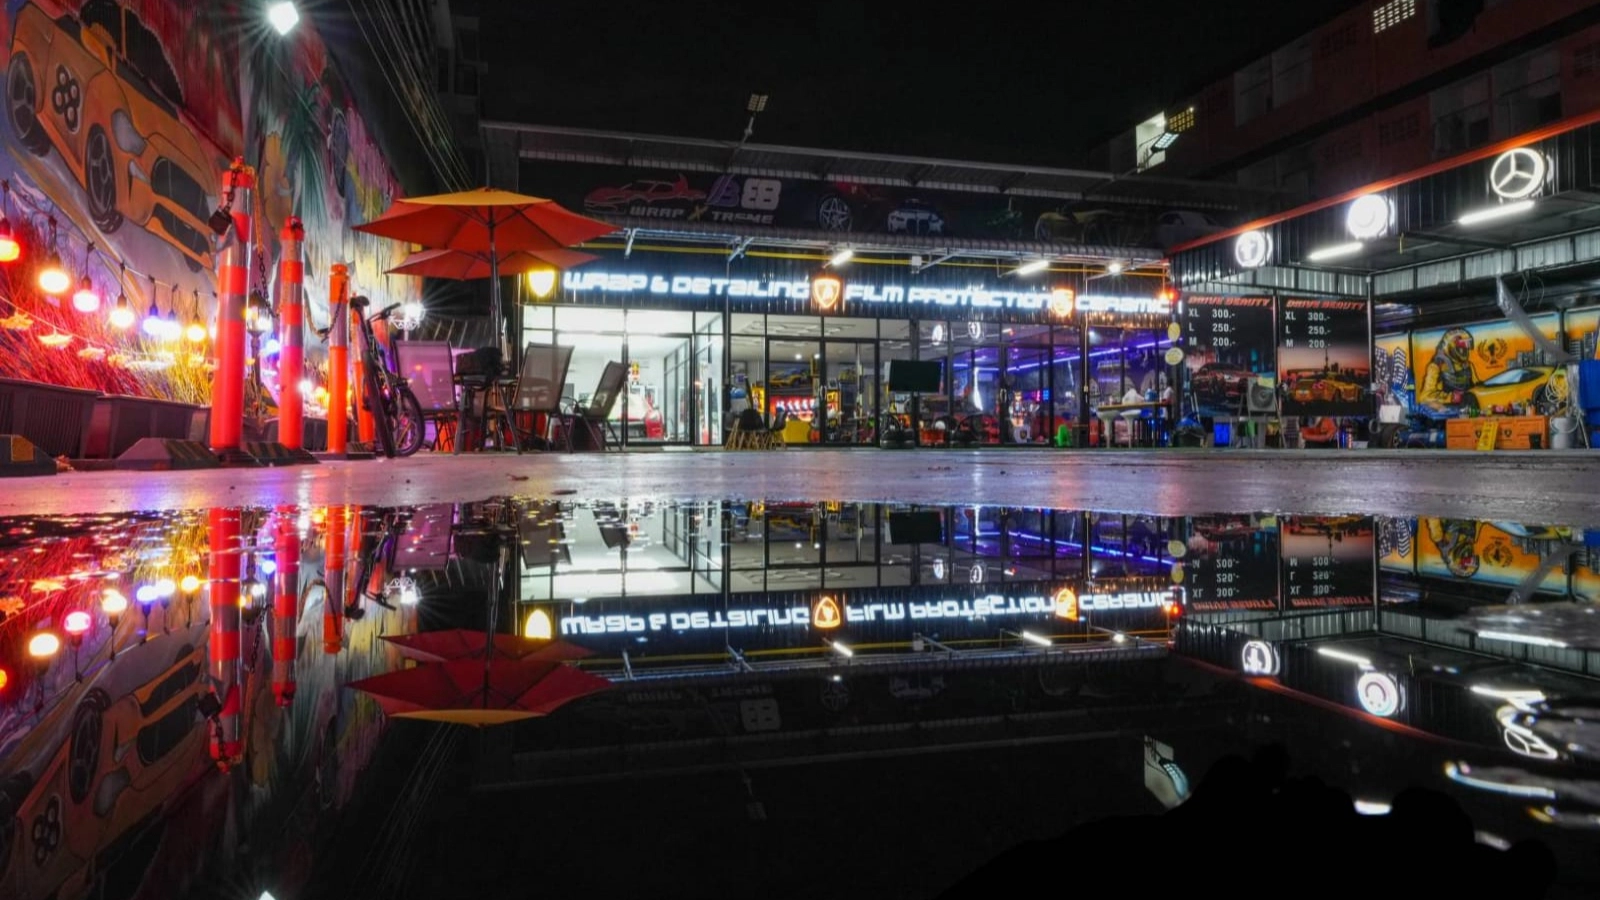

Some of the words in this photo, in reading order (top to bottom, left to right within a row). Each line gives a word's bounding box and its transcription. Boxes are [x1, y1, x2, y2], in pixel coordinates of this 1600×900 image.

[630, 206, 685, 218] WRAP
[687, 205, 709, 221] X
[564, 272, 648, 292] WRAP
[651, 276, 668, 293] &
[671, 277, 810, 299] DETAILING
[845, 285, 905, 303] FILM
[907, 286, 1054, 309] PROTECTION
[1075, 296, 1171, 313] CERAMIC
[1188, 310, 1199, 318] XL
[1212, 309, 1236, 319] 300.-
[1285, 312, 1296, 321] XL
[1307, 312, 1331, 321] 300.-
[1189, 324, 1194, 332] L
[1212, 323, 1236, 333] 250.-
[1285, 326, 1291, 334] L
[1189, 337, 1197, 346] M
[1212, 337, 1236, 347] 200.-
[1286, 339, 1294, 348] M
